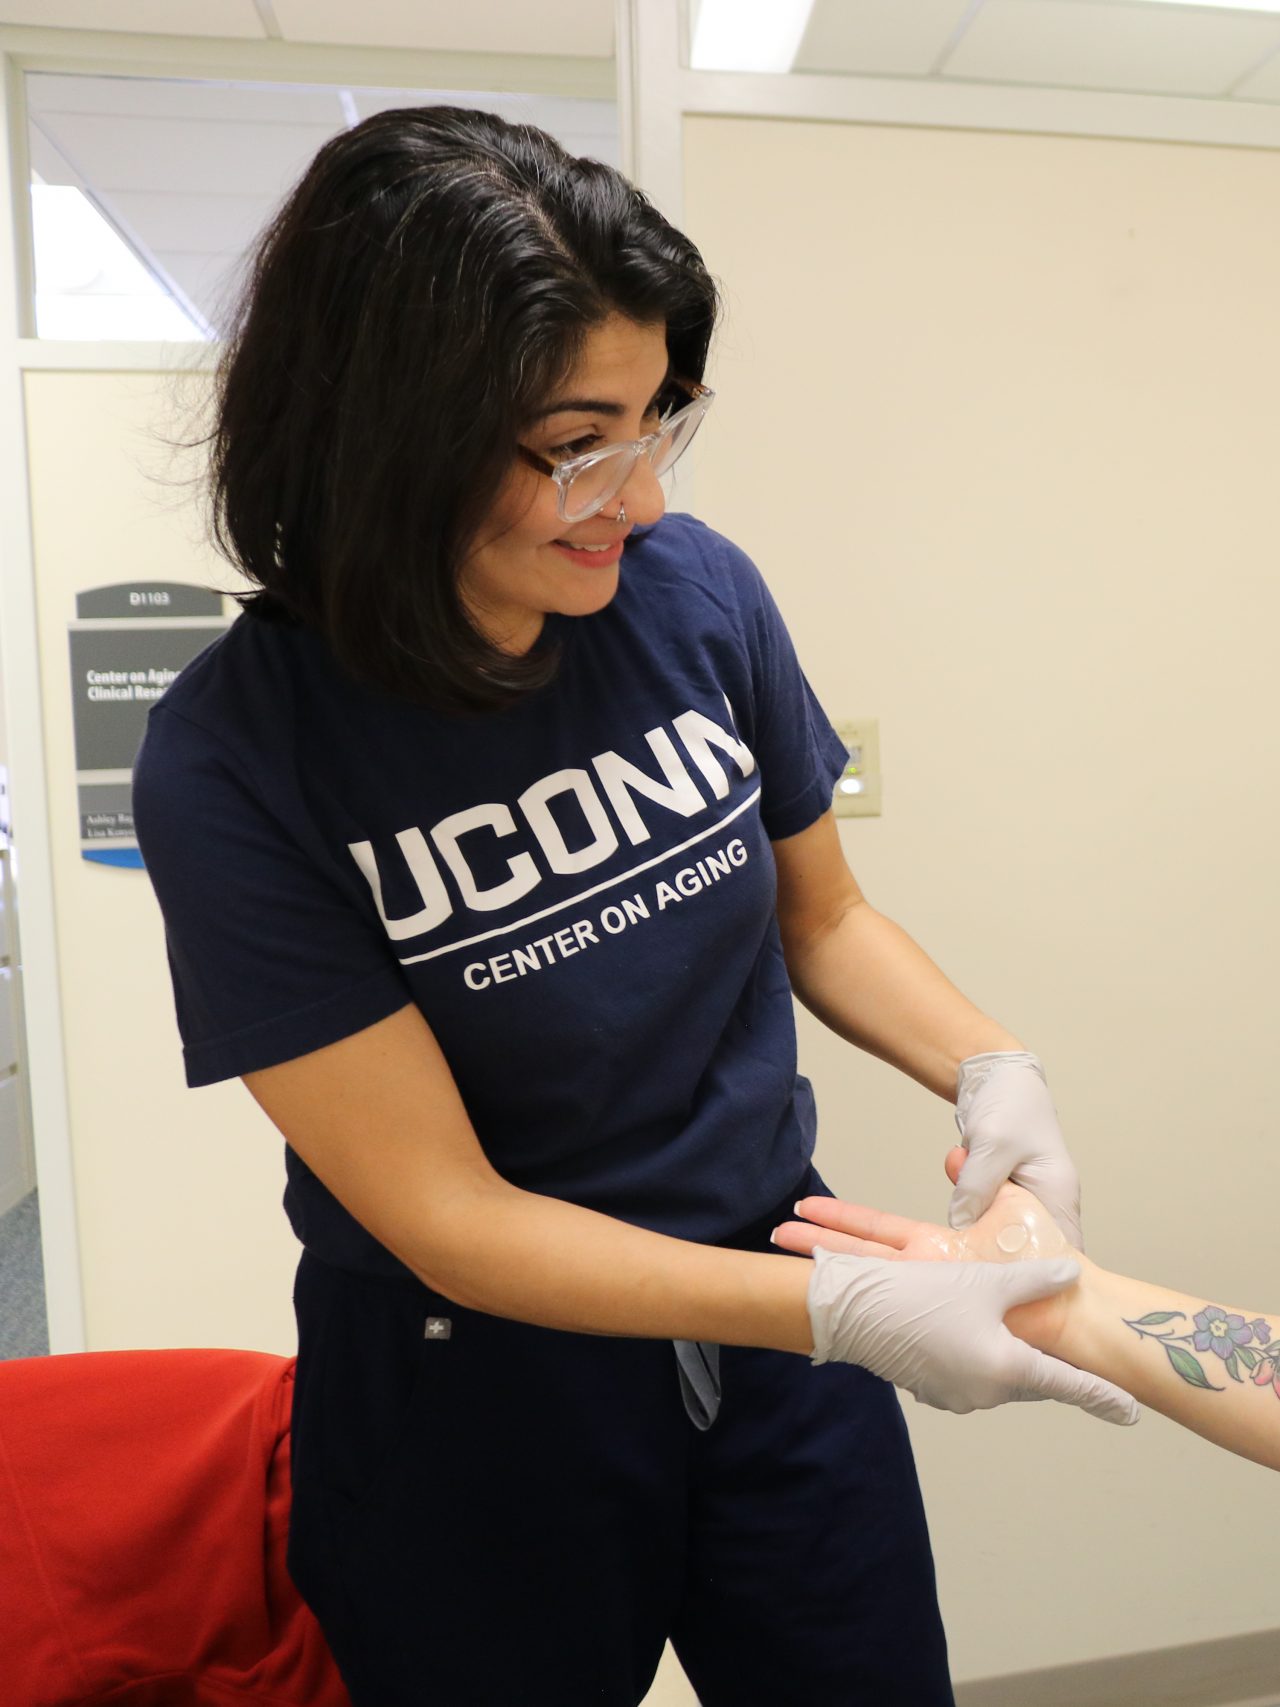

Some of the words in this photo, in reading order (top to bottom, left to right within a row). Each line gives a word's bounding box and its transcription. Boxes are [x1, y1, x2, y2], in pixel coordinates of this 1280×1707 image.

[130, 591, 170, 606] D1103
[87, 670, 128, 684] Center
[129, 671, 146, 684] on
[147, 668, 181, 687] Agin
[87, 685, 133, 701] Clinical
[348, 692, 755, 940] UCONN
[463, 920, 599, 990] CENTER
[600, 894, 650, 935] ON
[655, 838, 749, 910] AGING
